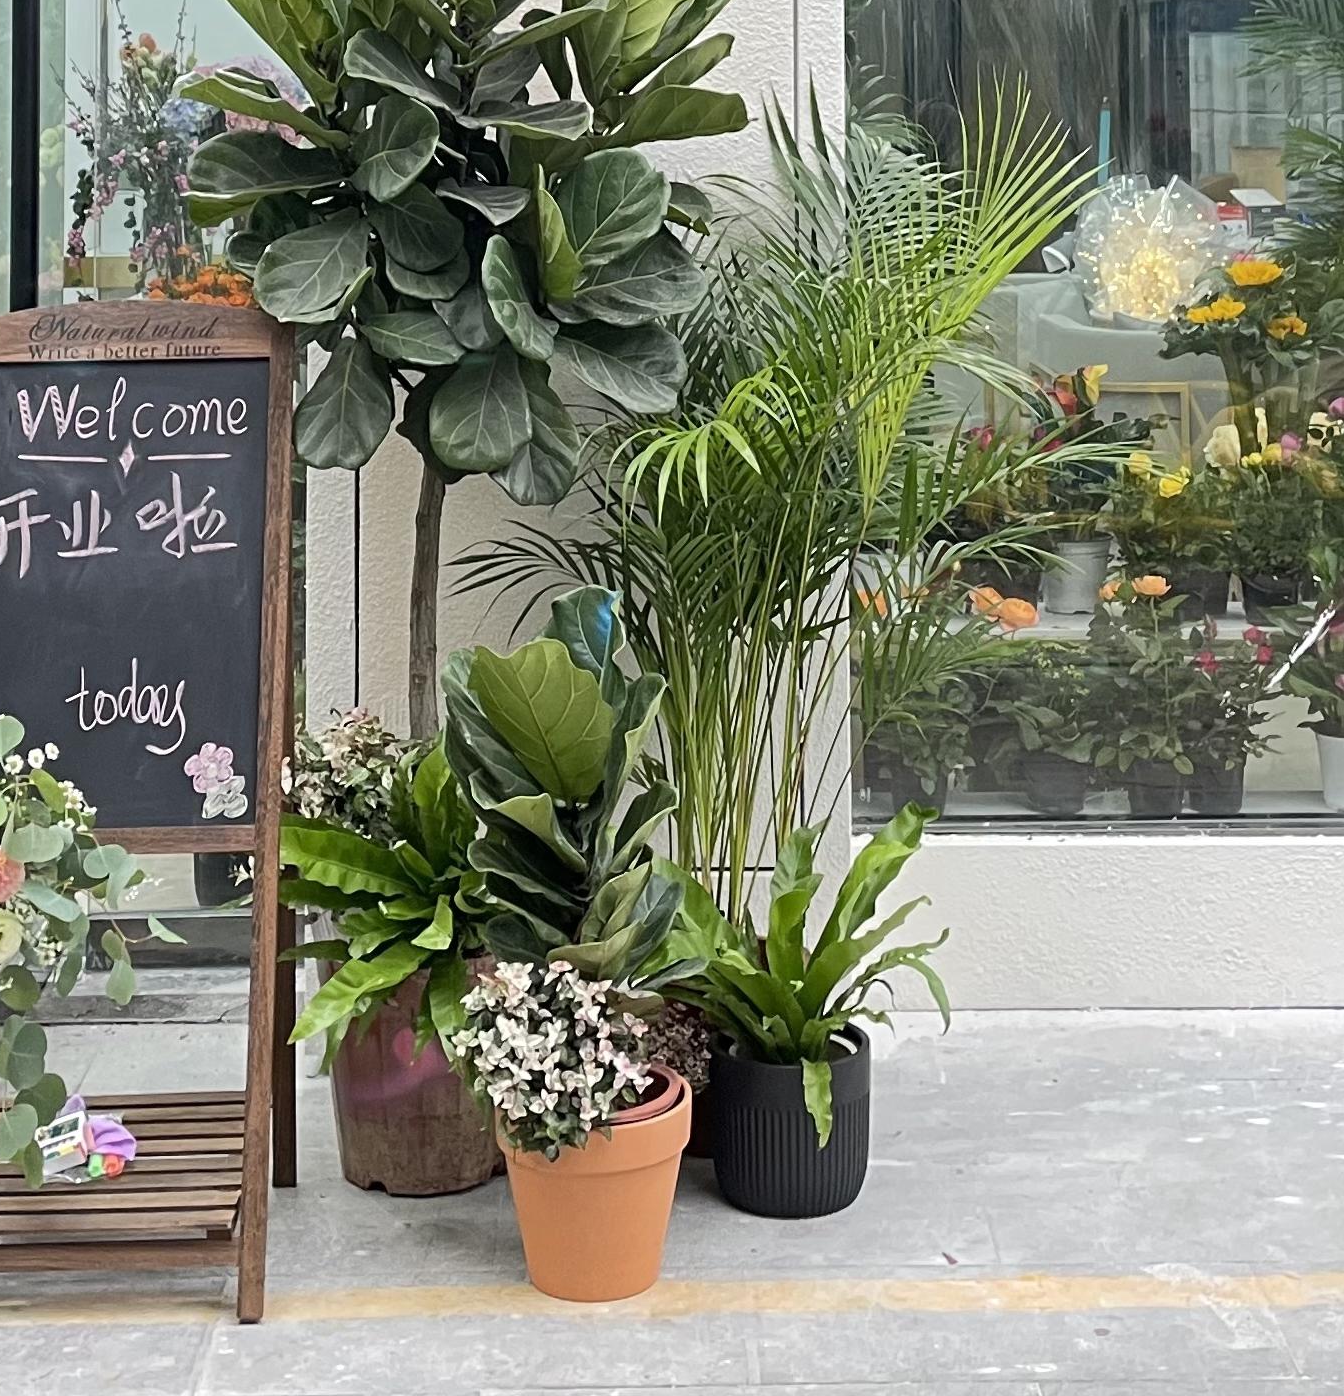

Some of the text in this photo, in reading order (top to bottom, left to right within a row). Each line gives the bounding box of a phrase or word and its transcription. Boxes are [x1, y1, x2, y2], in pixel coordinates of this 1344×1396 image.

[29, 314, 219, 342] Natural wind
[29, 342, 222, 360] Write a better future
[16, 376, 248, 443] Welcome
[65, 657, 186, 755] today
